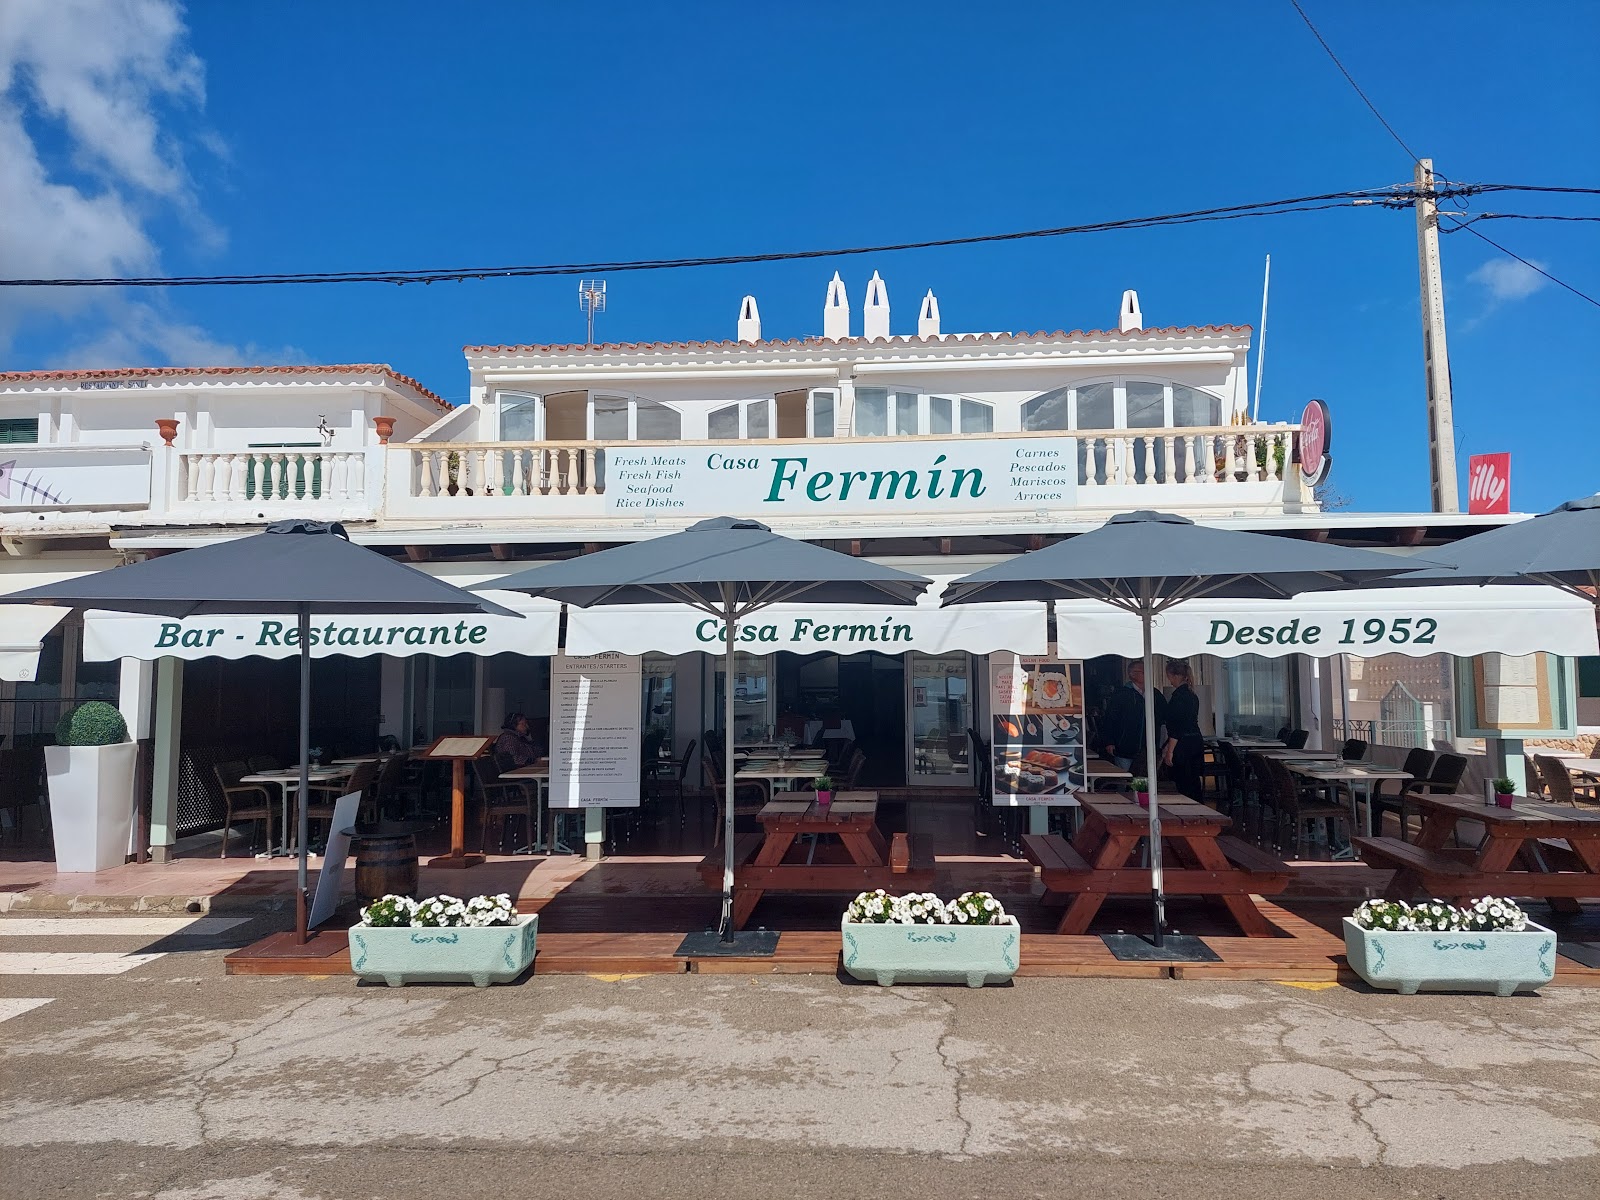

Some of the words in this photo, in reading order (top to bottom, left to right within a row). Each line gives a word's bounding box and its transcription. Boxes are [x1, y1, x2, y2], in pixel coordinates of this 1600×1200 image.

[1015, 448, 1060, 458] Carnes
[614, 456, 648, 467] Fresh
[650, 455, 687, 467] Meats
[706, 452, 760, 470] Casa
[1008, 461, 1067, 473] Pescados
[618, 469, 652, 480] Fresh
[655, 469, 682, 480] Fish
[762, 454, 987, 502] Fermín
[1009, 476, 1067, 487] Mariscos
[1470, 463, 1506, 510] illy
[626, 483, 674, 495] Seafood
[1013, 491, 1063, 501] Arroces
[616, 498, 642, 509] Rice
[644, 497, 685, 508] Dishes
[154, 622, 225, 648] Bar
[255, 620, 488, 647] Restaurante
[789, 616, 914, 642] Fermín
[1206, 618, 1322, 645] Desde
[1338, 617, 1438, 645] 1952
